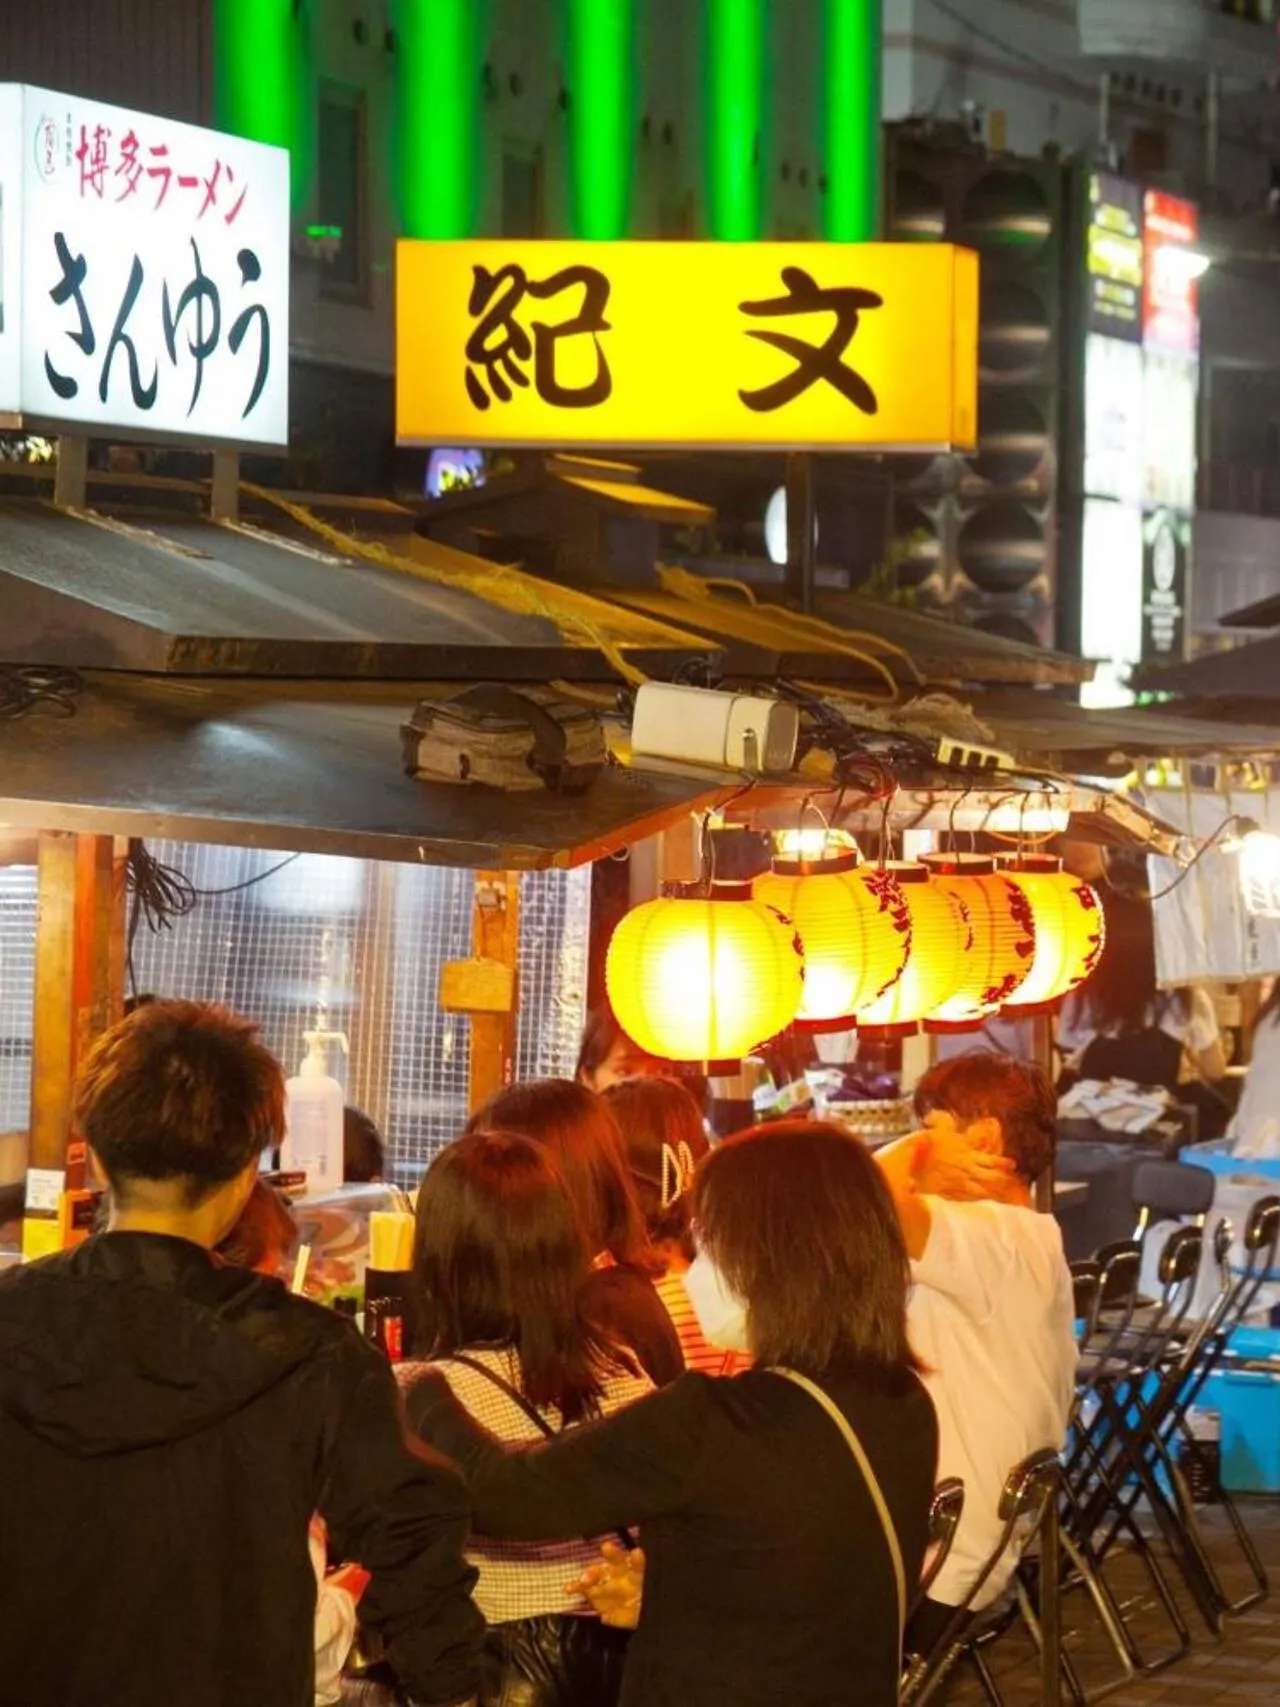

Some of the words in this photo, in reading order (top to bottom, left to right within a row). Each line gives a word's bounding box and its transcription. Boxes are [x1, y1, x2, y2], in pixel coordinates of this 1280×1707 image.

[75, 123, 248, 226] 博多ラーメン
[44, 231, 271, 420] さんゆう
[465, 264, 883, 415] 紀文
